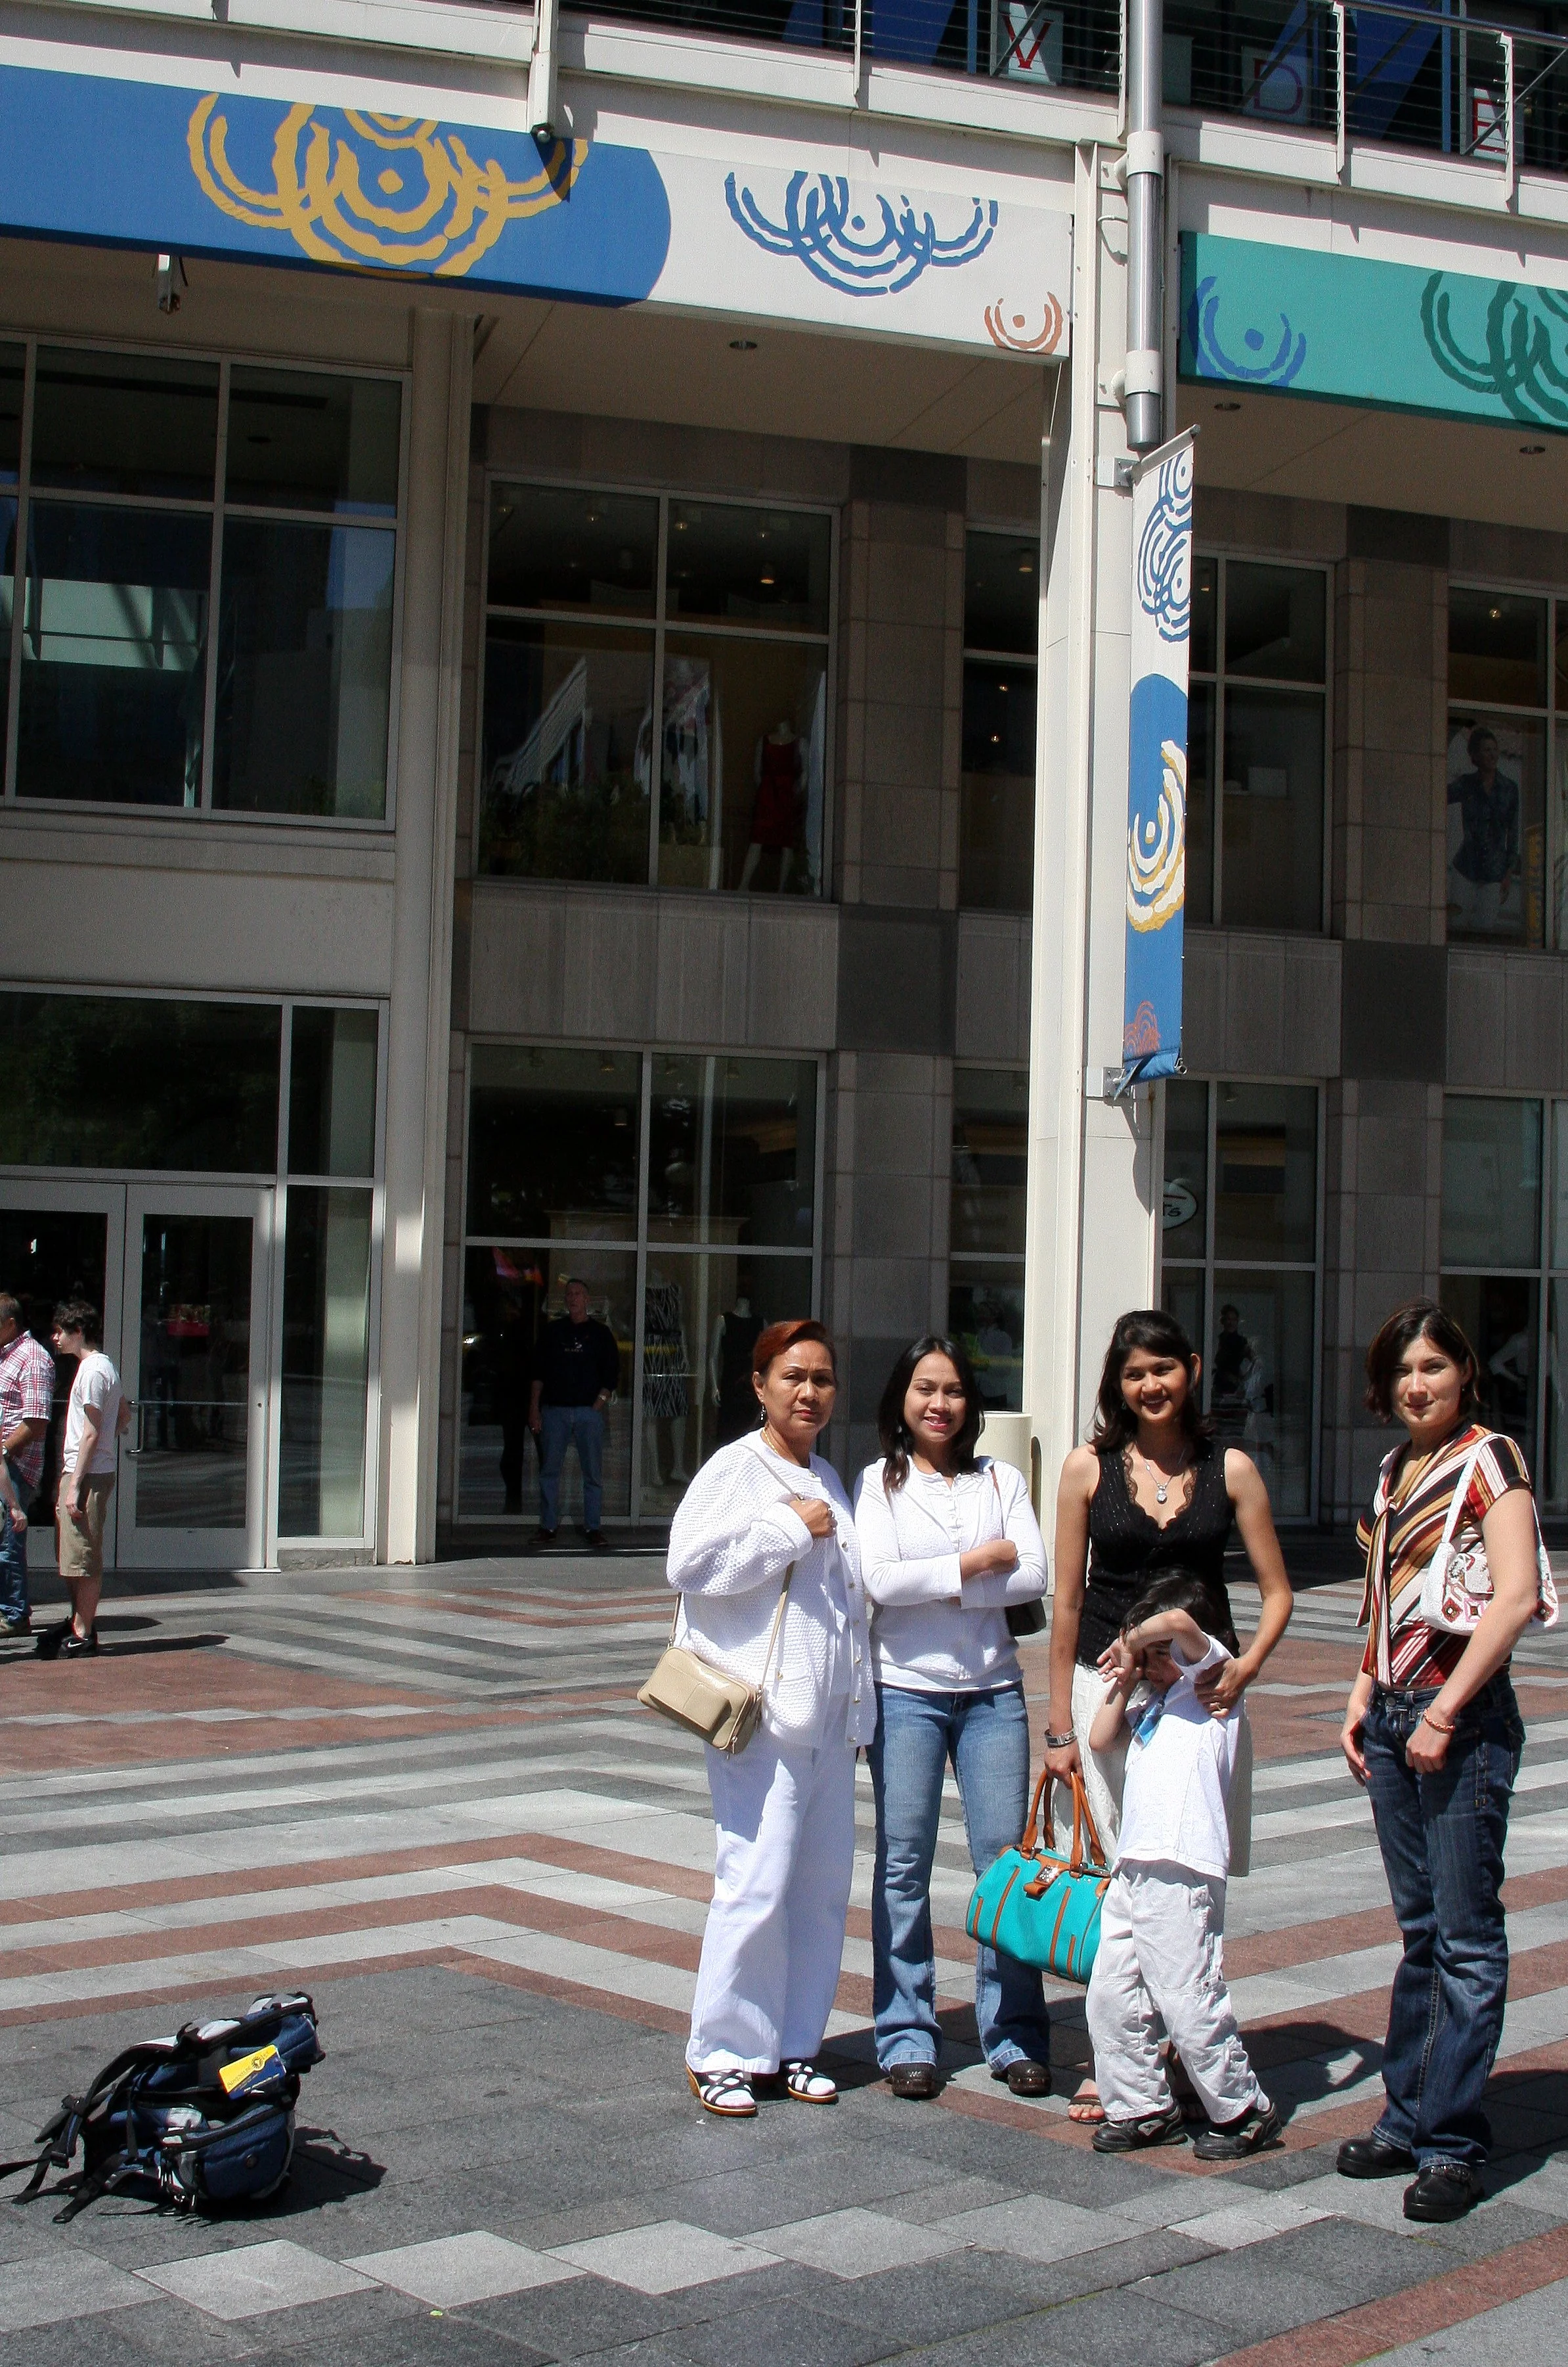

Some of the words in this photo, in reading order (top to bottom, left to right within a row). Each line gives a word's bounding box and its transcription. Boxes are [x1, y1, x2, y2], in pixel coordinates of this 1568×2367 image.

[1002, 14, 1054, 70] V
[1253, 57, 1303, 115] D
[1472, 97, 1506, 154] E
